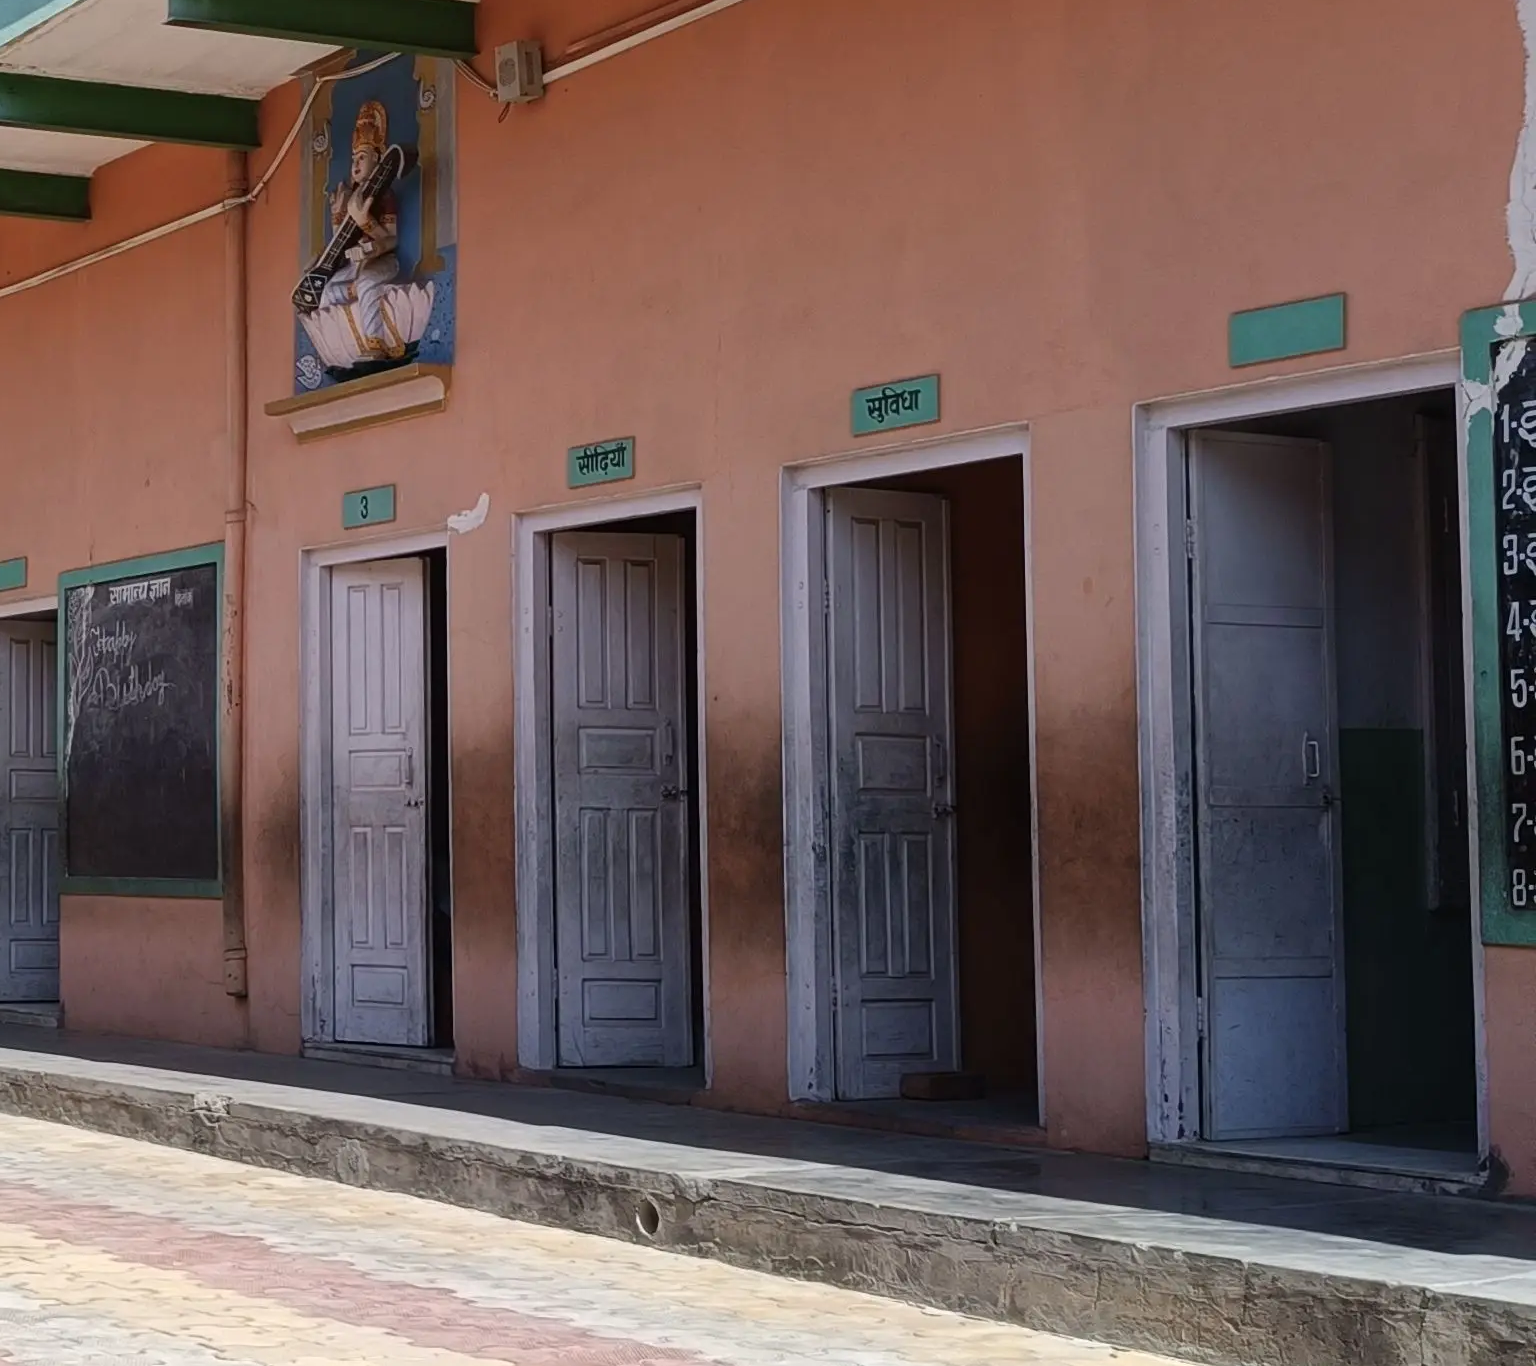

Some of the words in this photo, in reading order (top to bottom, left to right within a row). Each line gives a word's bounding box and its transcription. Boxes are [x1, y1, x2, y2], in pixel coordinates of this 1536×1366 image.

[865, 387, 921, 423] सुविधा
[360, 495, 369, 520] 3
[108, 582, 148, 605] सामान्य
[148, 577, 171, 601] ज्ञान
